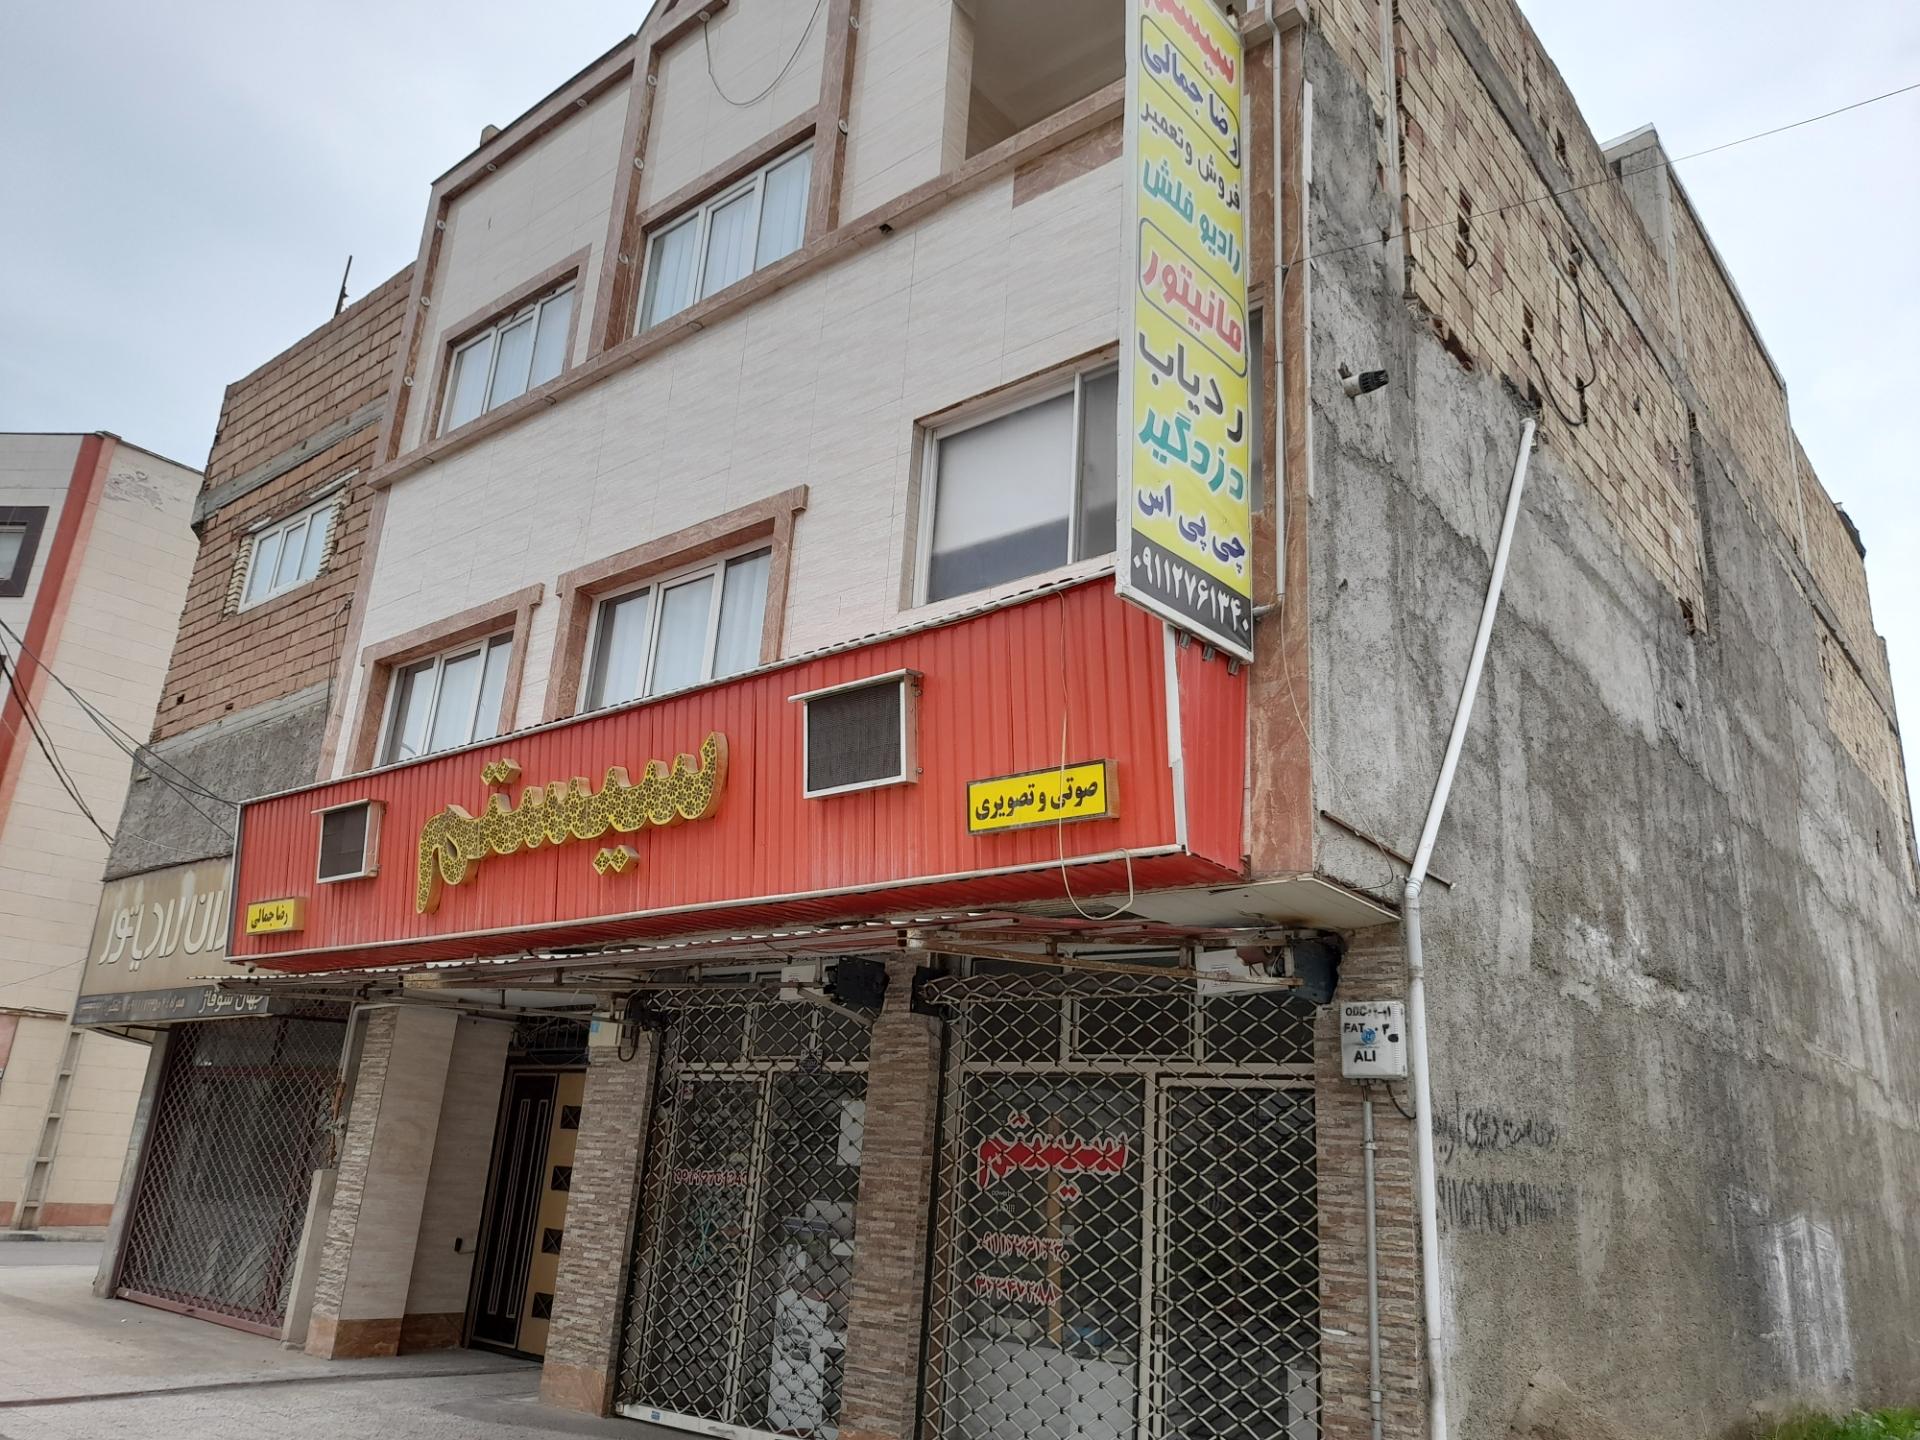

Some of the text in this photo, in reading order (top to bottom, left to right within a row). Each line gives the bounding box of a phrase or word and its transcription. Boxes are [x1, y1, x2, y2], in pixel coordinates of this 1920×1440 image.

[1140, 102, 1185, 142] تعمیر
[1143, 43, 1238, 159] رضا جمالی
[1142, 158, 1241, 275] رادیو فلش
[1197, 153, 1241, 211] فروش
[1142, 250, 1243, 353] مانیتور
[1138, 407, 1245, 501] دزدگیر
[1138, 484, 1172, 517] اس
[1133, 545, 1250, 633] ۰۹۱۱۲۷۶۱۳۴۰
[416, 731, 728, 914] سیستم
[975, 783, 1036, 821] تصویری
[1050, 777, 1099, 810] صوتی
[98, 896, 186, 973] رادیاتور
[250, 904, 289, 930] رضا جمالی
[1353, 1050, 1377, 1063] ALI
[977, 1111, 1129, 1202] سیستم
